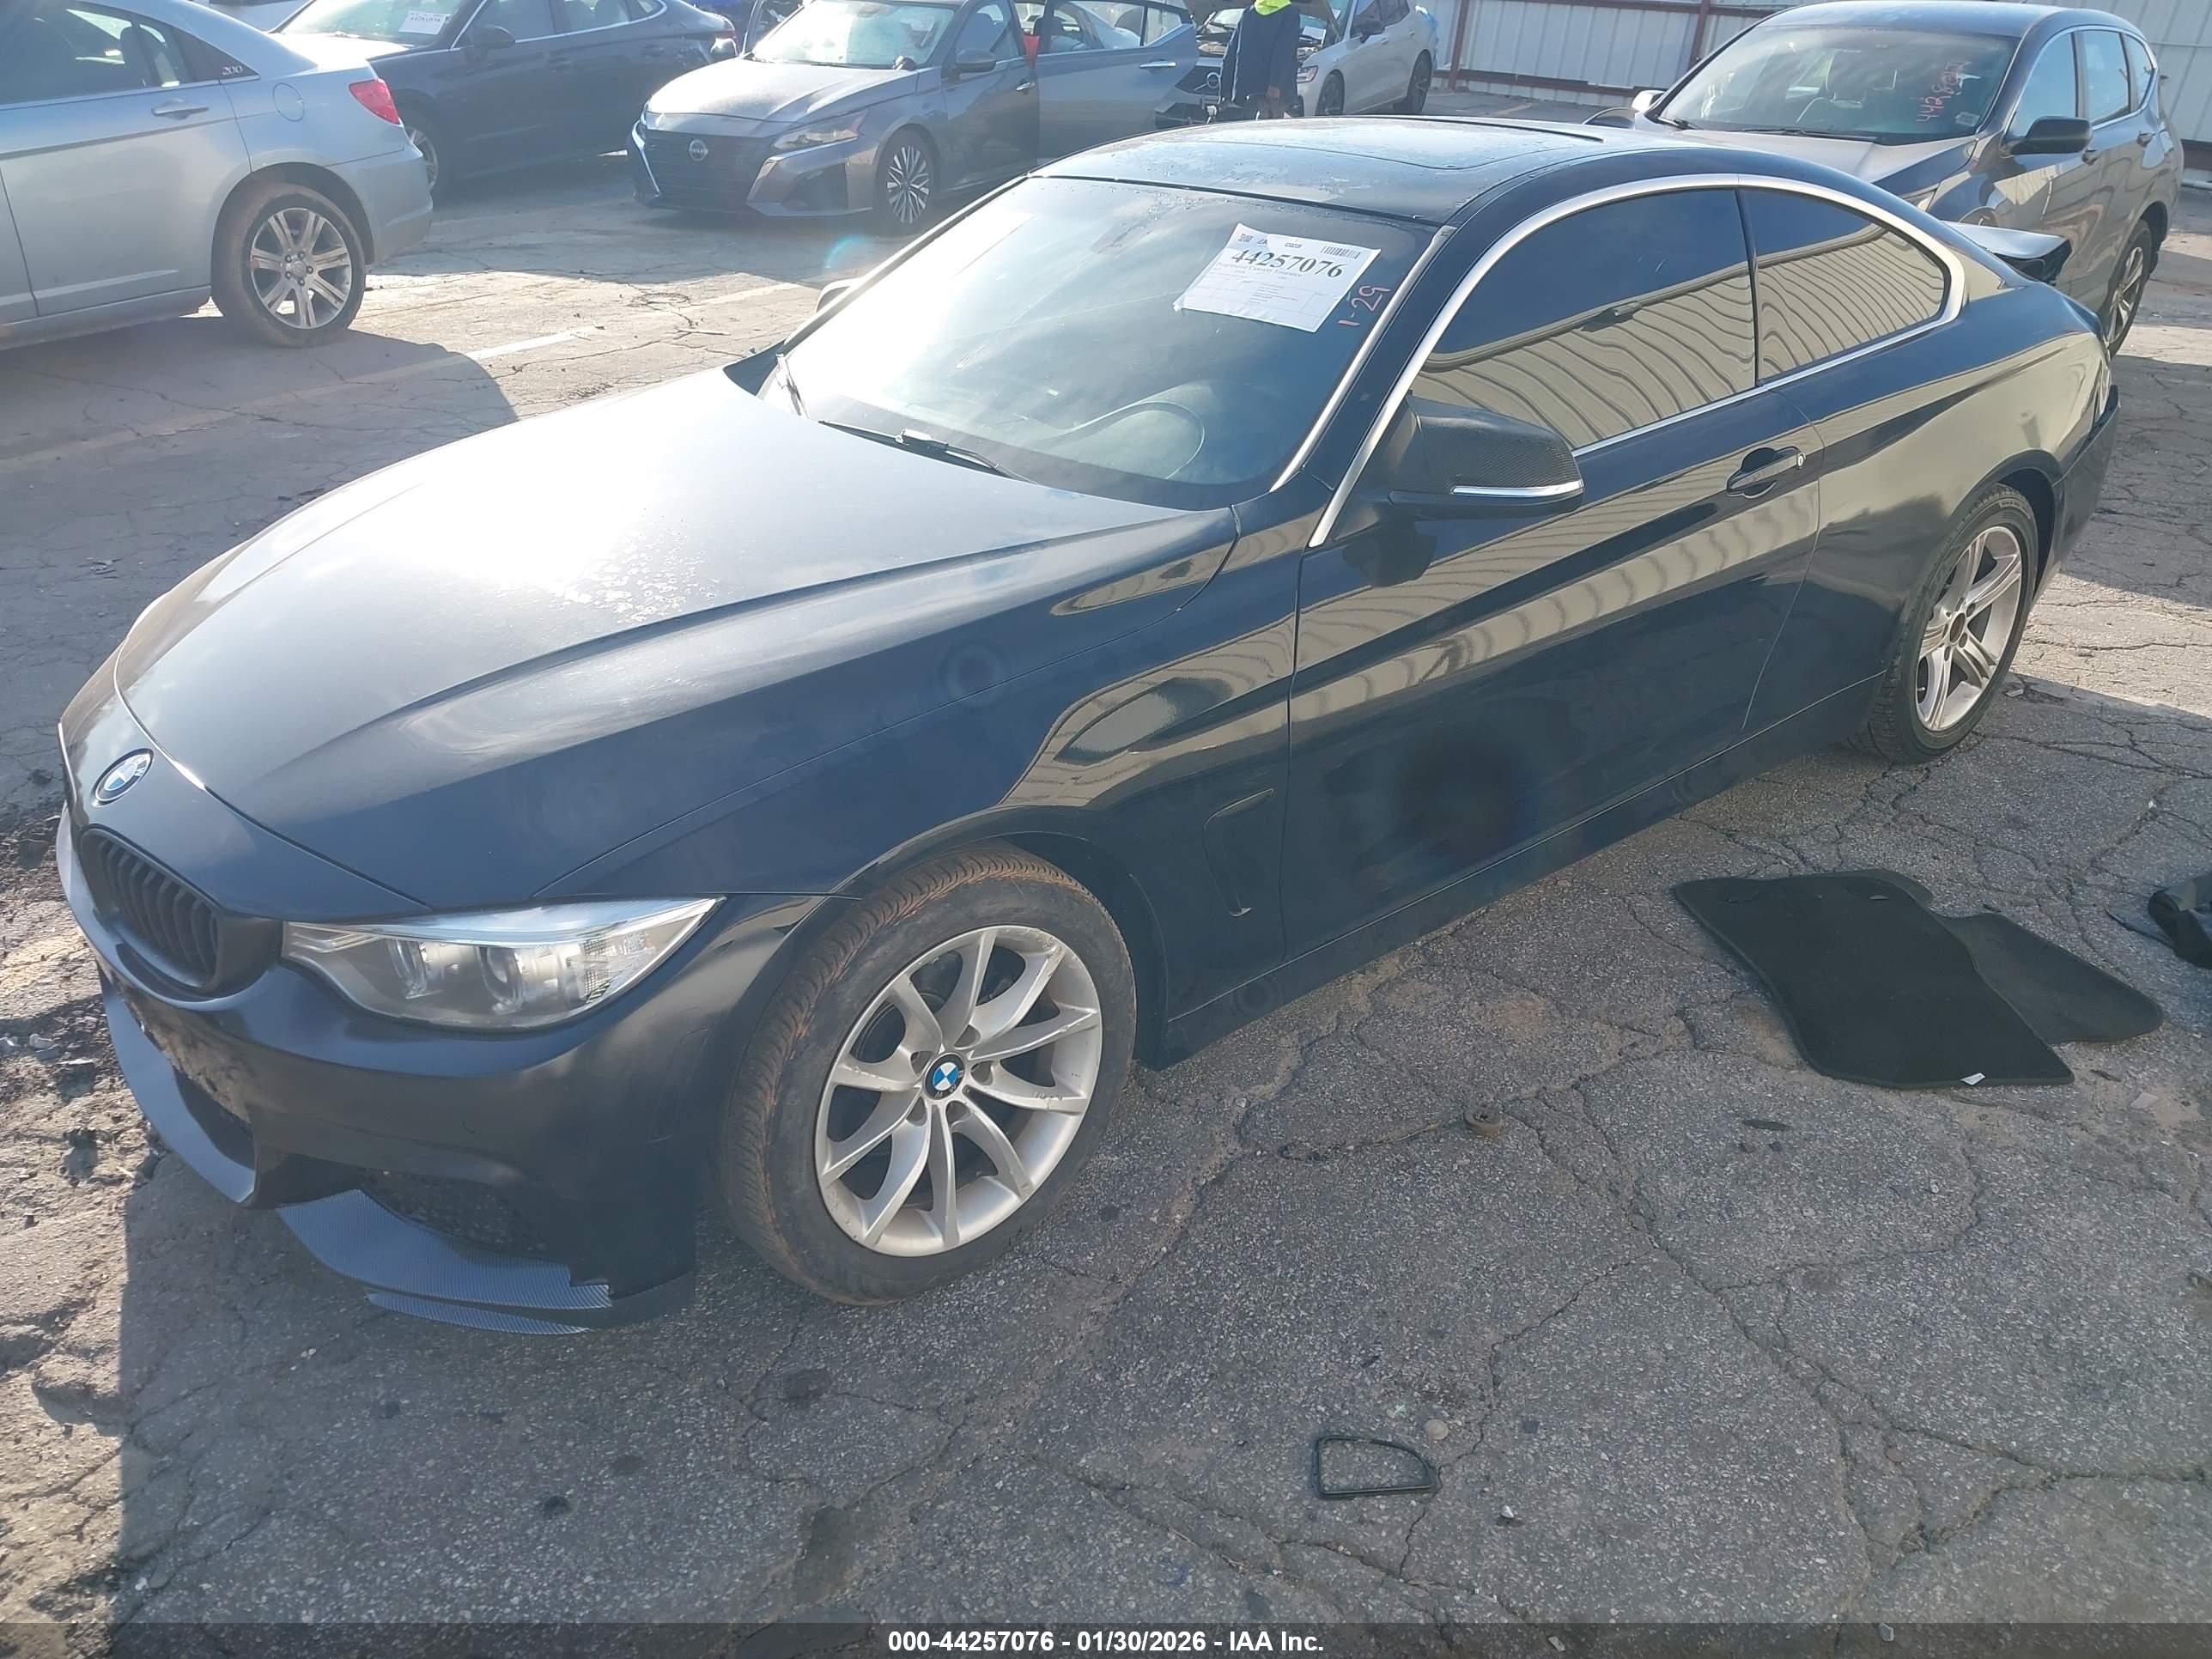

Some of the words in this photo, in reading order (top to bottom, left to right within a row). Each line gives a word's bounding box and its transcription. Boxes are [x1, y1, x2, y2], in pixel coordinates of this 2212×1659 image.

[221, 65, 243, 76] 200
[1231, 249, 1348, 278] 44257076
[1337, 285, 1393, 327] 1-29
